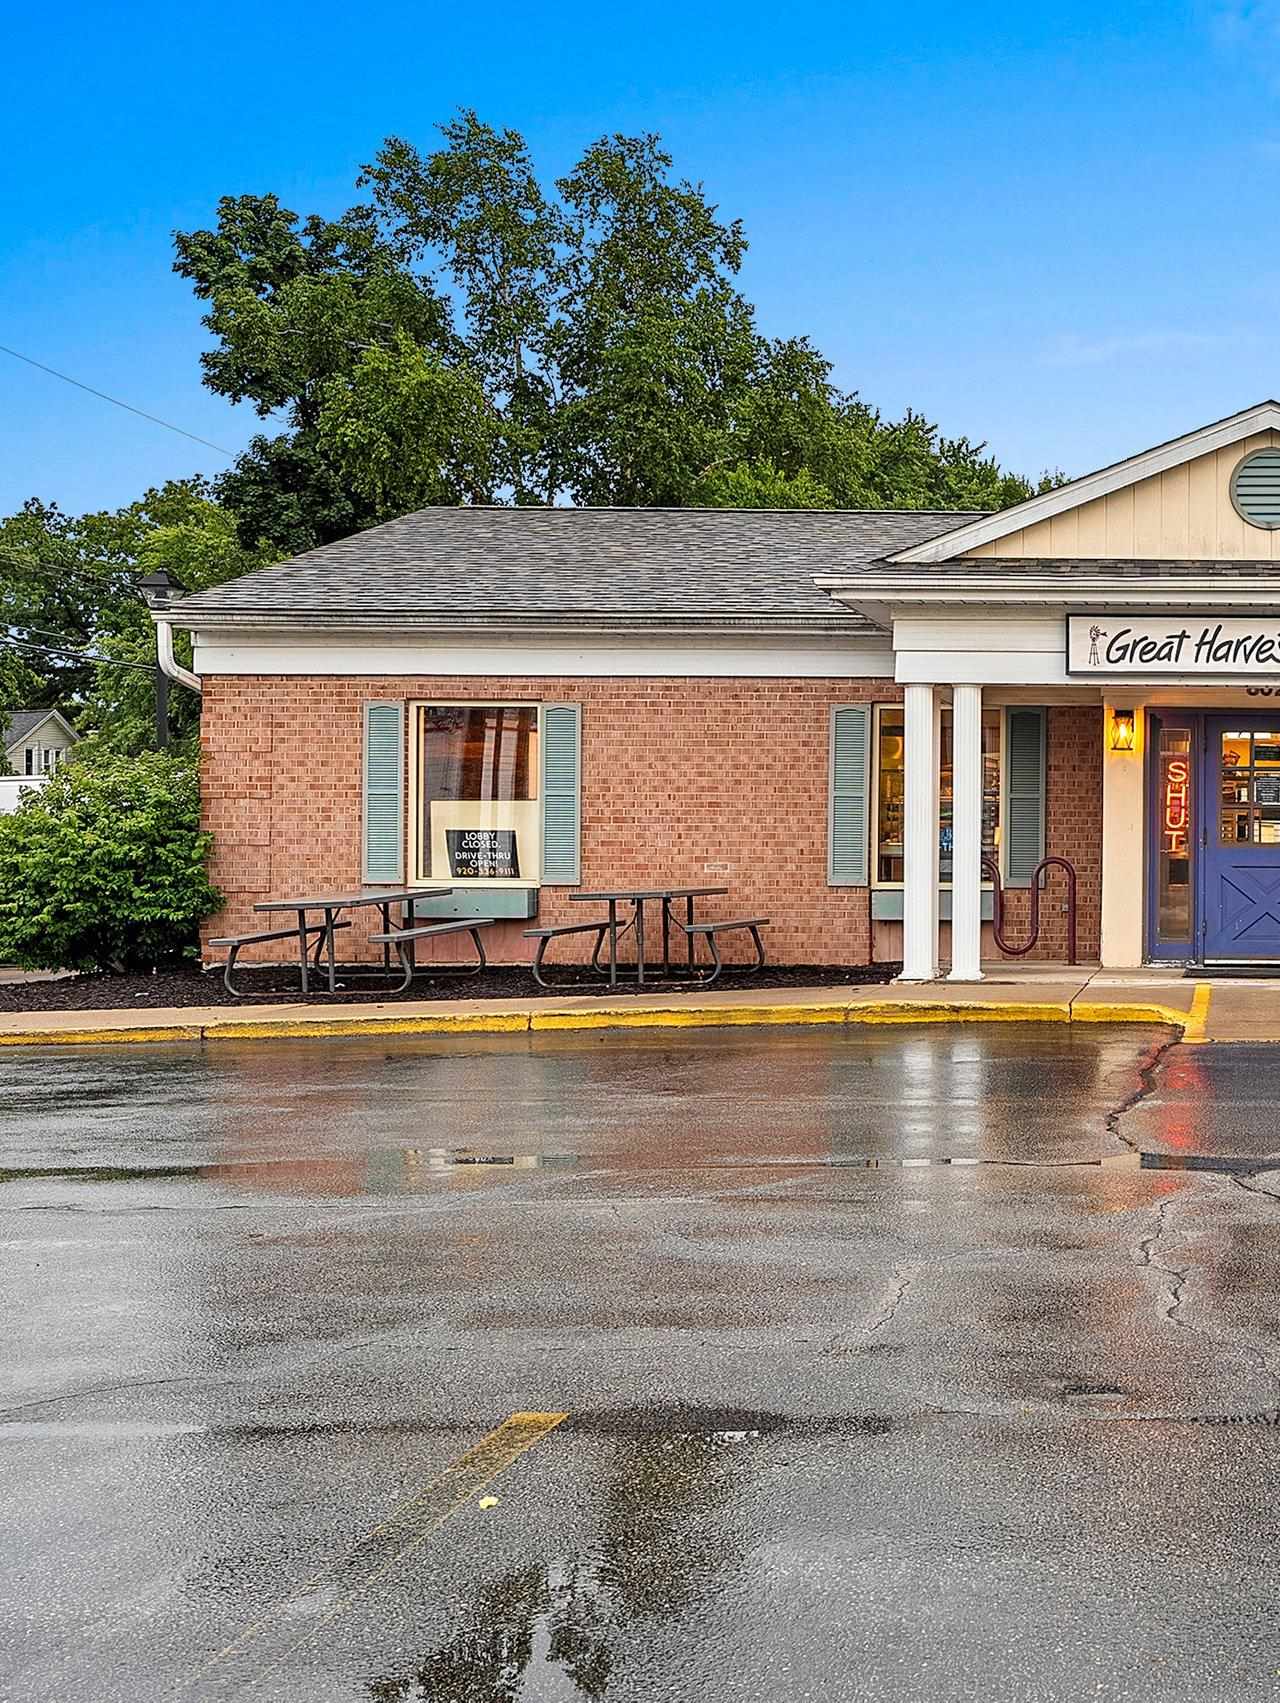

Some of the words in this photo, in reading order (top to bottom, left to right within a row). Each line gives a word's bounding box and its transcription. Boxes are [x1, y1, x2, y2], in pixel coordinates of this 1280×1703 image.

[1106, 629, 1190, 664] Great
[1164, 762, 1186, 851] SHUT
[465, 832, 495, 840] LOBBY
[461, 840, 501, 848] CLOSED.
[455, 852, 511, 860] DRIVE-THRU
